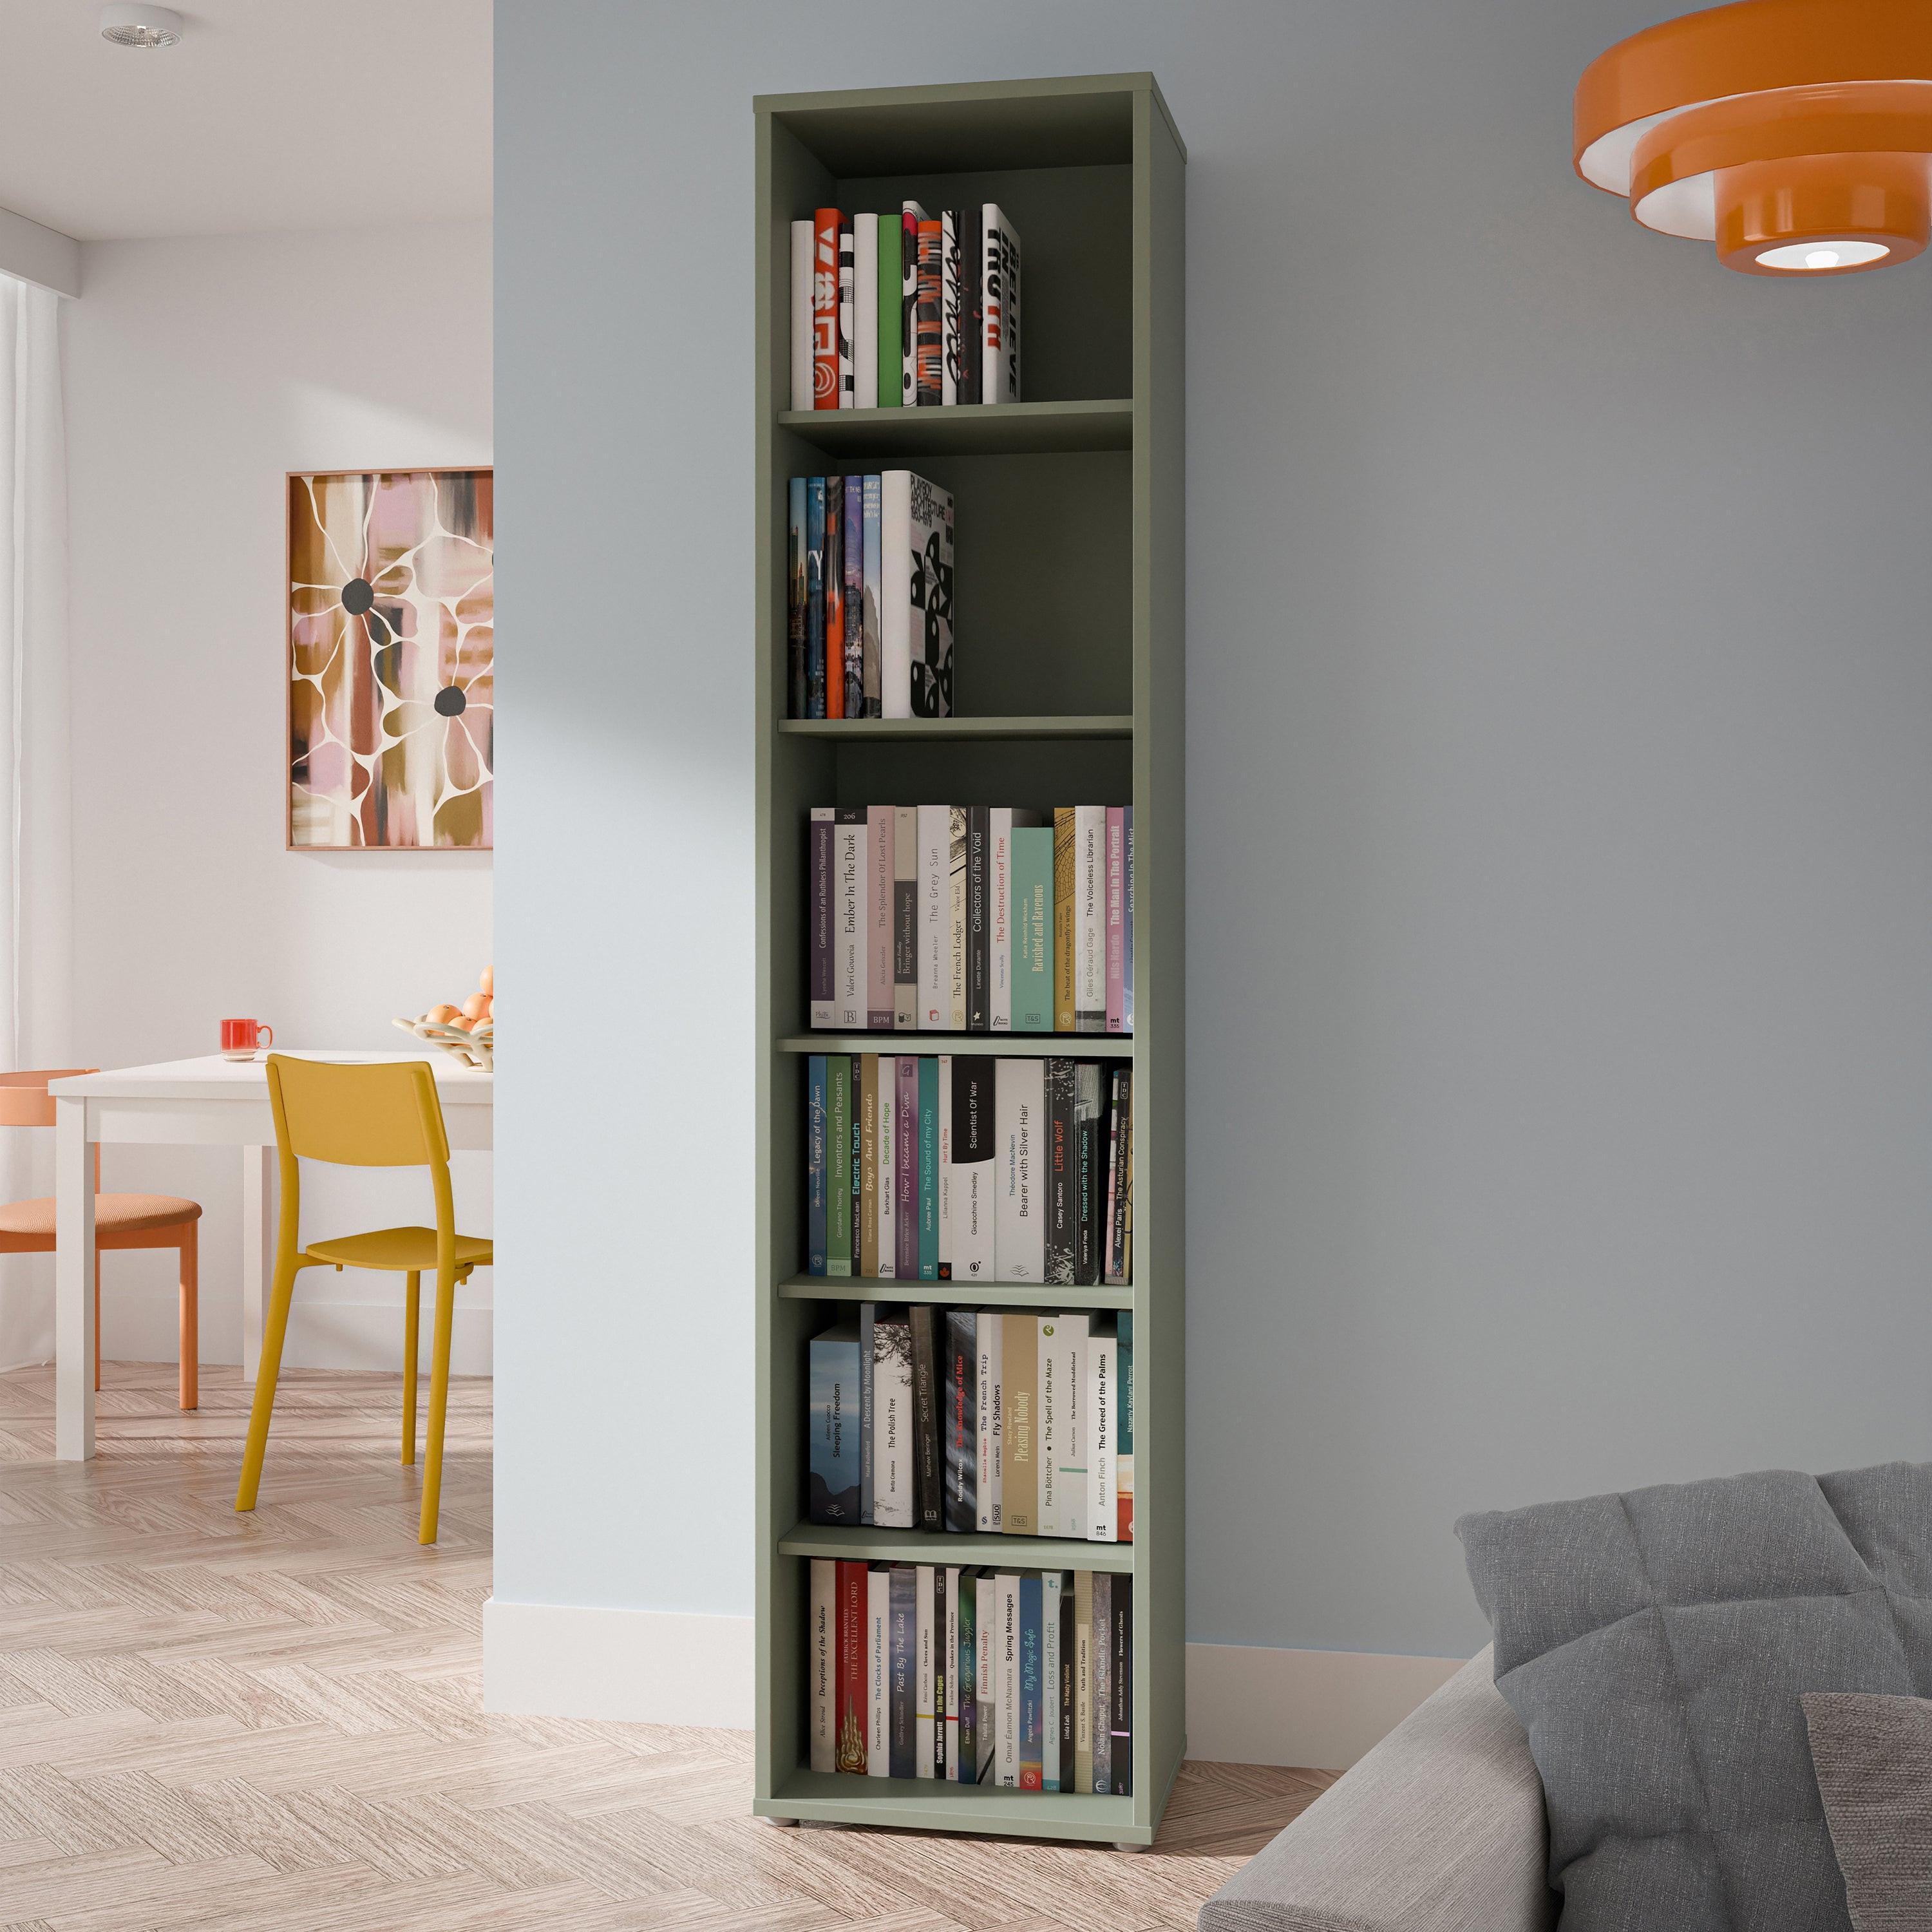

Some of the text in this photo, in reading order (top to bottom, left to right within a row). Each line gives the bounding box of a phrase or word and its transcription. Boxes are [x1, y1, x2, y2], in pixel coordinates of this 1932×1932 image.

[1002, 229, 1009, 275] IN
[987, 227, 1001, 351] TRUTH
[911, 474, 933, 500] PLAYBOY
[911, 490, 945, 521] ARCHITECTURE
[879, 864, 886, 873] Of
[1110, 826, 1119, 925] The Man In The Portrait
[844, 835, 855, 933] Ember In The Dark
[930, 874, 940, 898] Grey
[972, 833, 981, 932] Collectors of the Void
[903, 893, 911, 973] Bringer without hope
[953, 920, 963, 948] Lodger
[1032, 886, 1044, 971] Ravished and Ravenous
[924, 1109, 933, 1124] City
[970, 1099, 976, 1108] Of
[924, 1140, 931, 1148] of
[926, 1126, 932, 1138] my
[1054, 1121, 1063, 1142] Wolf
[852, 1123, 860, 1195] Electric Touch
[919, 1364, 928, 1396] Triangle
[1045, 1393, 1052, 1403] of
[1099, 1397, 1105, 1405] of
[833, 1423, 842, 1457] Sleeping
[1014, 1391, 1030, 1462] Pleasing Nobody
[896, 1613, 905, 1634] Lake
[896, 1638, 905, 1654] The
[897, 1658, 905, 1669] By
